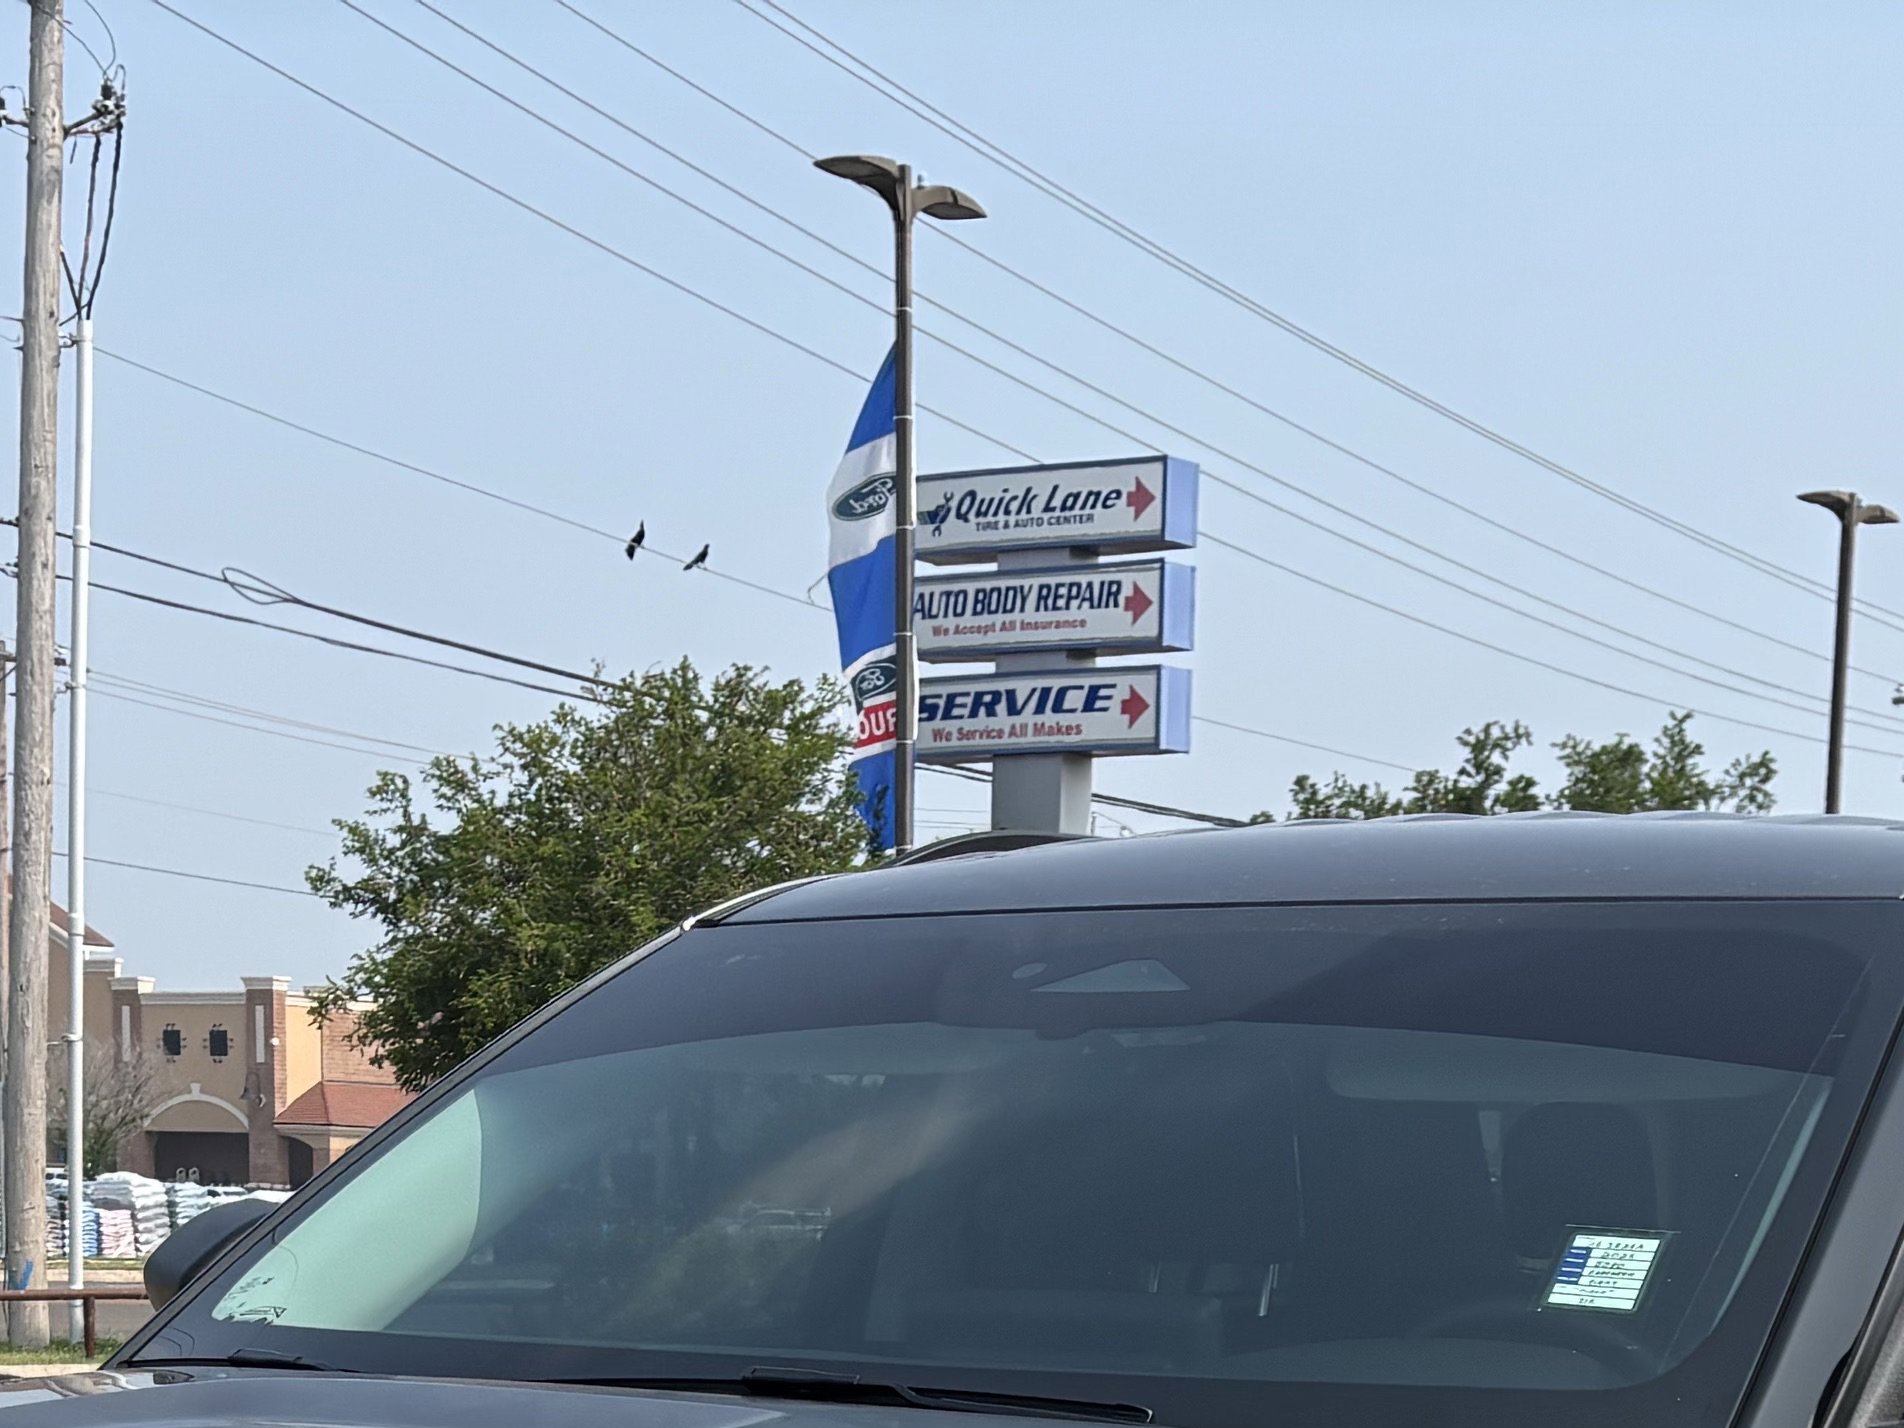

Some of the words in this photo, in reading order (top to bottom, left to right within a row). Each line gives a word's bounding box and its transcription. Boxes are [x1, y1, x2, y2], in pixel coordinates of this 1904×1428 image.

[955, 486, 1039, 523] Quick
[1041, 484, 1123, 514] Lane
[975, 522, 1000, 532] TIRE
[1013, 517, 1045, 529] AUTO
[1047, 513, 1095, 526] CENTER
[913, 588, 969, 620] AUTO
[971, 584, 1033, 616] BODY
[1035, 580, 1122, 612] REPAIR
[931, 624, 950, 637] We
[953, 621, 996, 637] Accept
[999, 619, 1017, 632] All
[1020, 617, 1088, 632] Insurance
[918, 683, 1118, 722] SERVICE
[931, 727, 953, 743] We
[956, 726, 1006, 742] Service
[1008, 723, 1028, 738] All
[1032, 721, 1083, 738] Makes
